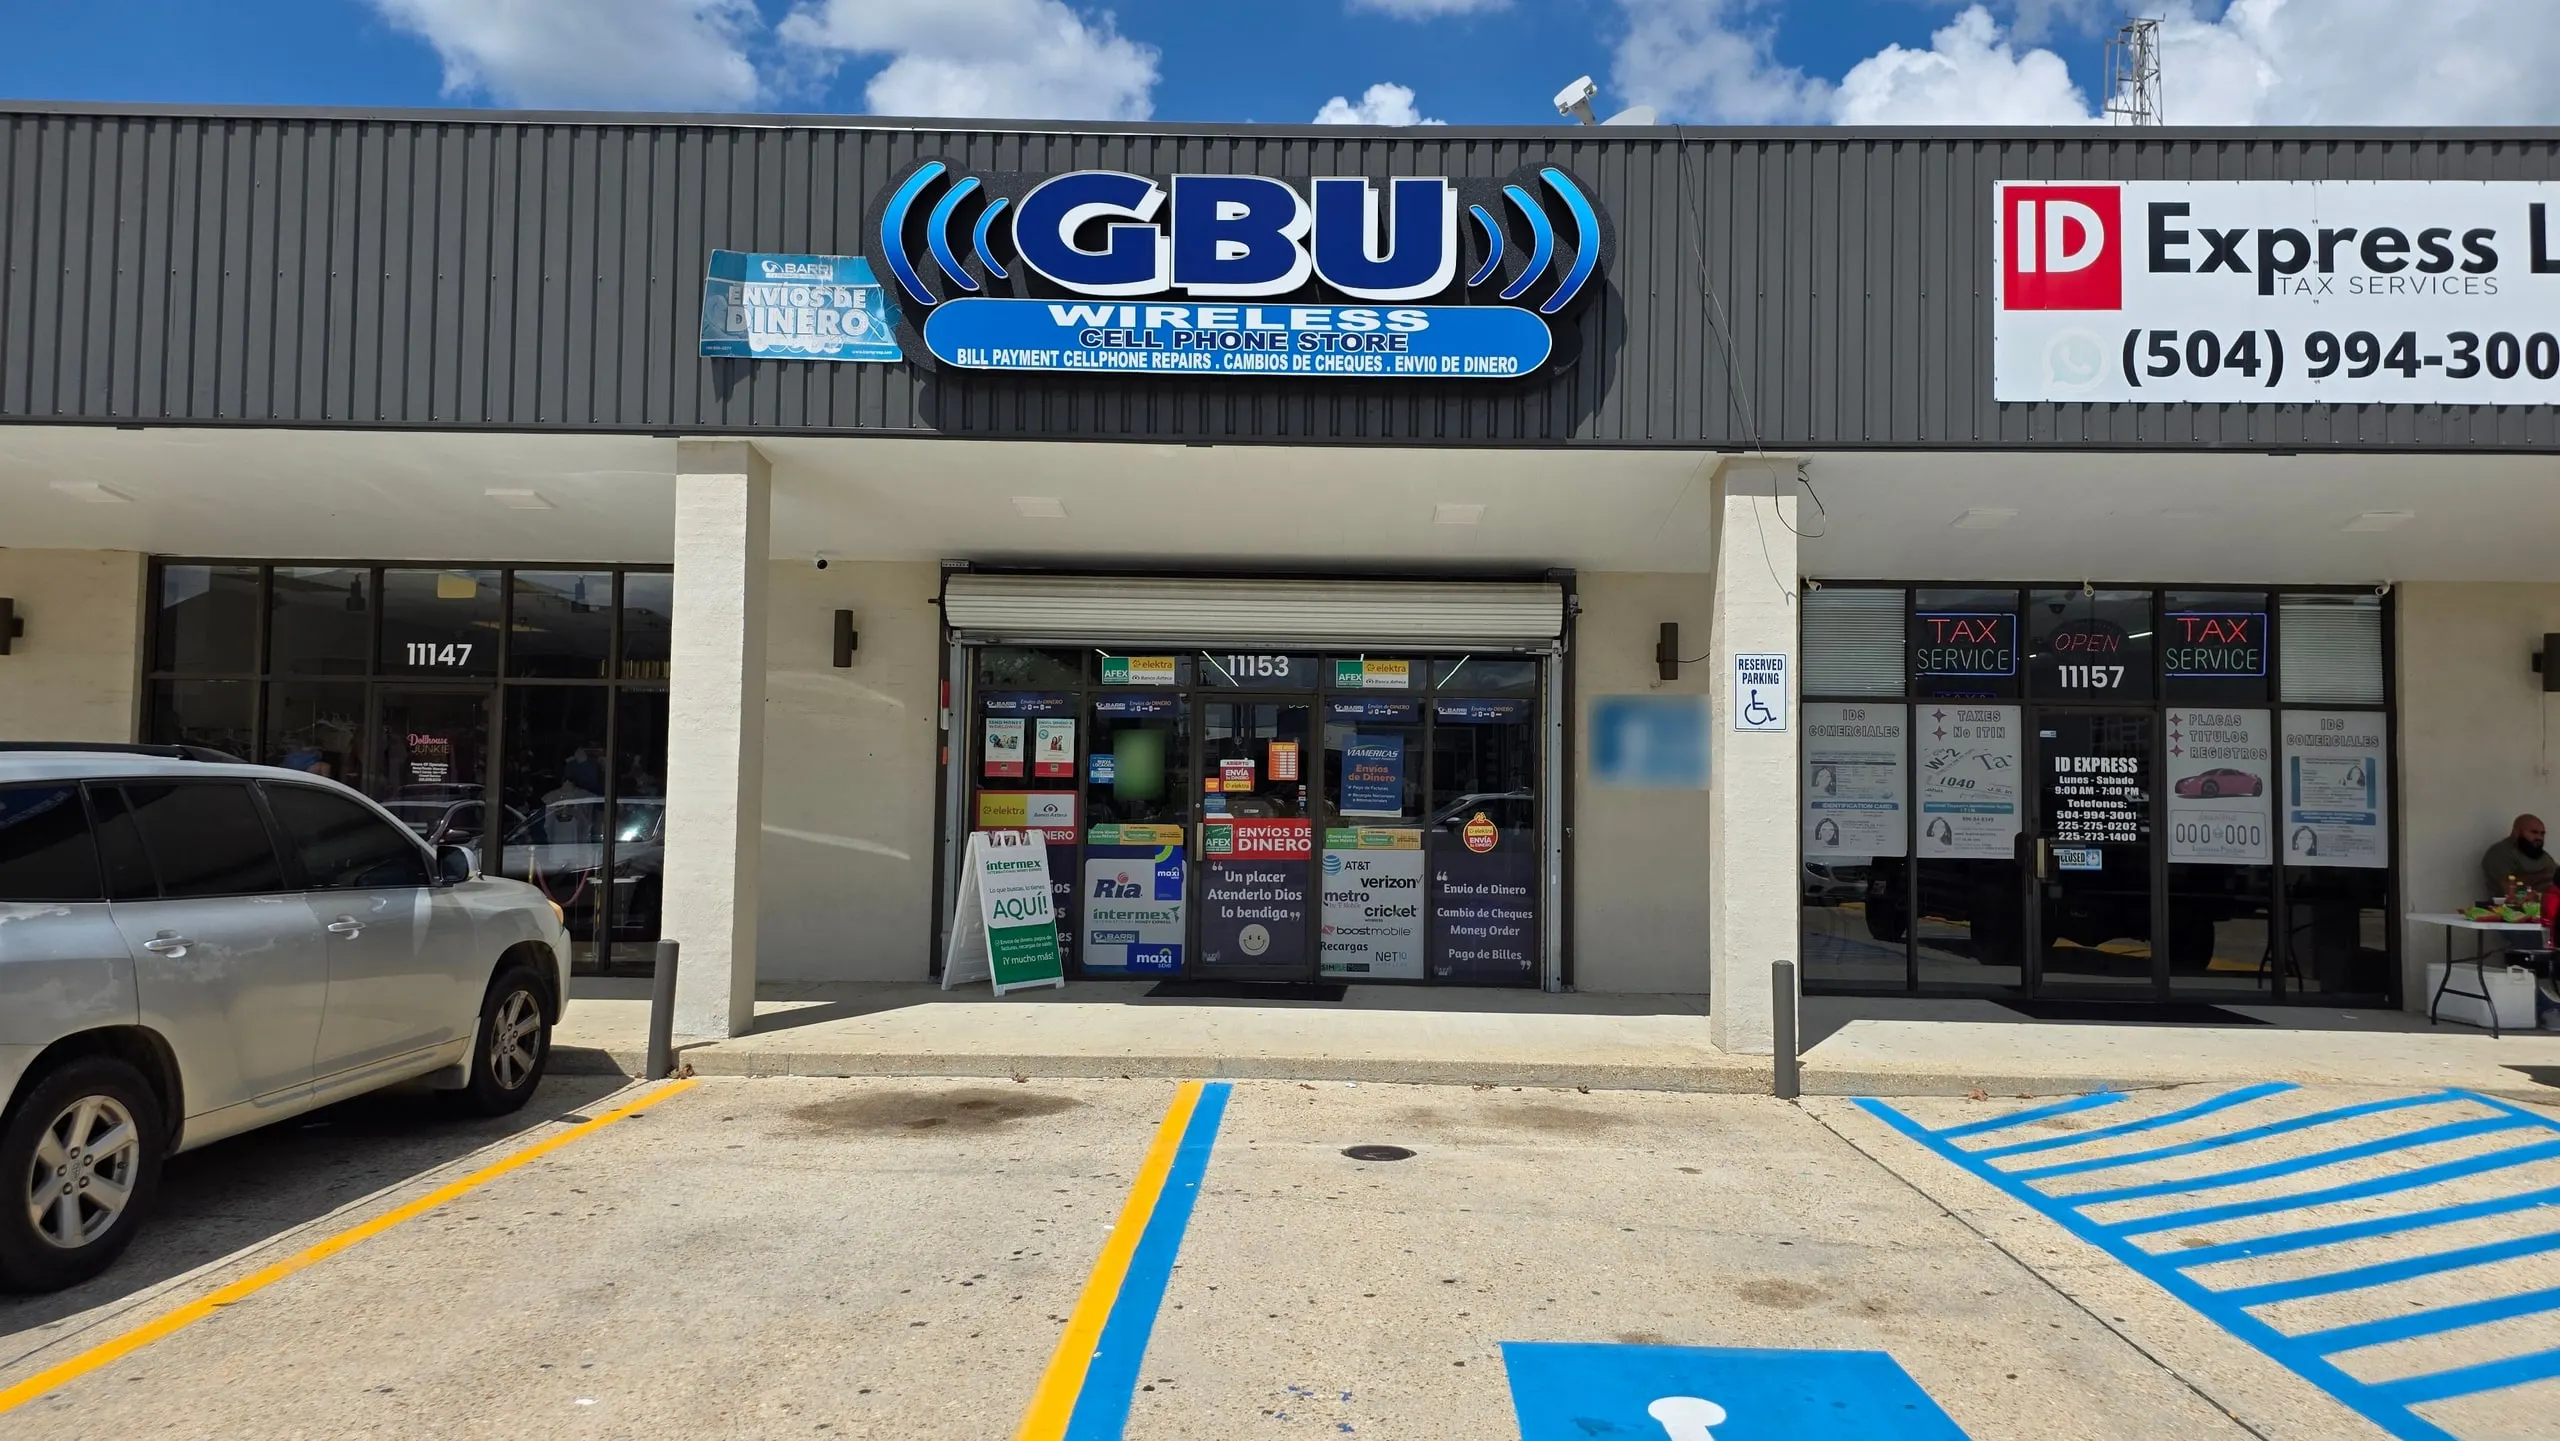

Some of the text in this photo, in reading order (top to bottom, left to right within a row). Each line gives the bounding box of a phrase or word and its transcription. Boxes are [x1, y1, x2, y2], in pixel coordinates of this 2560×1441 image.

[1012, 169, 1458, 300] GBU
[2017, 199, 2105, 274] ID
[2148, 202, 2499, 296] Express
[784, 263, 833, 275] BARRI
[2277, 275, 2499, 296] TAX SERVICES
[833, 285, 867, 309] DE
[726, 305, 870, 336] DINERO
[1047, 304, 1431, 332] WIRELESS
[1078, 328, 1409, 353] CELL PHONE STORE
[956, 347, 989, 366] BILL
[992, 348, 1060, 367] PAYMENT
[1063, 350, 1148, 369] CELLPHONE
[1152, 352, 1211, 370] REPAIRS
[1223, 353, 1289, 371] CAMBIOS
[1292, 354, 1311, 371] DE
[1316, 354, 1383, 373] CHEQUES
[1441, 356, 1460, 374] DE
[1463, 356, 1518, 375] DINERO
[2121, 329, 2560, 387] (504) 994-300
[1927, 618, 1998, 644] TAX
[2176, 617, 2248, 643] TAX
[2054, 631, 2121, 653] OPEN
[406, 642, 473, 666] 11147
[1916, 648, 2009, 671] SERVICE
[2165, 647, 2259, 670] SERVICE
[1141, 660, 1173, 669] elektra
[1227, 655, 1290, 677] 11153
[1376, 664, 1407, 673] elektra
[1738, 658, 1783, 671] RESERVED
[1104, 669, 1129, 678] AFEX
[1338, 673, 1362, 681] AFEX
[1742, 672, 1780, 685] PARKING
[2057, 664, 2125, 688] 11157
[1842, 709, 1866, 721] IDS
[1957, 710, 2001, 722] TAXES
[2188, 713, 2242, 727] PLACAS
[1808, 724, 1900, 738] COMERCIALES
[2320, 718, 2345, 731] IDS
[1953, 726, 2006, 739] No ITIN
[2189, 730, 2249, 743] TITULOS
[407, 733, 449, 746] Dollhouse
[2286, 733, 2379, 748] COMERCIALES
[411, 744, 450, 755] JUNKIE
[1347, 749, 1399, 758] VIAMERICAS
[2189, 746, 2268, 760] REGISTROS
[1924, 748, 1961, 772] W-2
[1972, 752, 2013, 771] Ta
[2055, 756, 2138, 774] ID EXPRESS
[1225, 768, 1249, 776] ENVÍA
[1348, 773, 1396, 782] de Dinero
[1939, 776, 1976, 789] 1040
[2059, 775, 2134, 785] Lunes Sabado
[2054, 786, 2140, 796] 9:00 AM 7:00 PM
[993, 805, 1025, 816] elektra
[2067, 799, 2128, 809] Telefonos:
[2056, 810, 2137, 820] 504-994-3001
[1238, 825, 1290, 837] ENVÍOS
[1294, 827, 1312, 837] DE
[2057, 821, 2137, 831] 225-275-0202
[1469, 836, 1492, 844] ENVÍA
[2058, 831, 2137, 841] 225-273-1400
[2175, 823, 2261, 846] 000 000
[1205, 838, 1230, 847] AFEX
[1238, 838, 1312, 851] DINERO
[2060, 852, 2086, 863] CLOSED
[985, 860, 1041, 871] intermex
[1344, 861, 1371, 870] AT&T
[1157, 868, 1180, 877] maxi
[1225, 870, 1286, 885] Un placer
[1093, 872, 1142, 899] Ria
[1360, 875, 1417, 889] verizon
[1207, 888, 1303, 901] Atenderlo Dios
[1324, 889, 1370, 902] metro
[1443, 883, 1527, 895] Envio de Dinero
[993, 891, 1048, 921] AQUÍ!
[1364, 904, 1417, 918] cricket
[1093, 908, 1171, 920] intermex
[1221, 905, 1288, 921] lo bendiga
[1437, 907, 1533, 920] Cambio de Cheques
[1106, 933, 1136, 941] BARRI
[1336, 926, 1412, 936] boostmobile
[1450, 924, 1520, 938] Money Order
[1320, 941, 1369, 953] Recargas
[1011, 953, 1037, 965] mucho
[1037, 952, 1055, 961] más!
[1136, 950, 1172, 964] maxi
[1448, 948, 1523, 961] Pago de Billes
